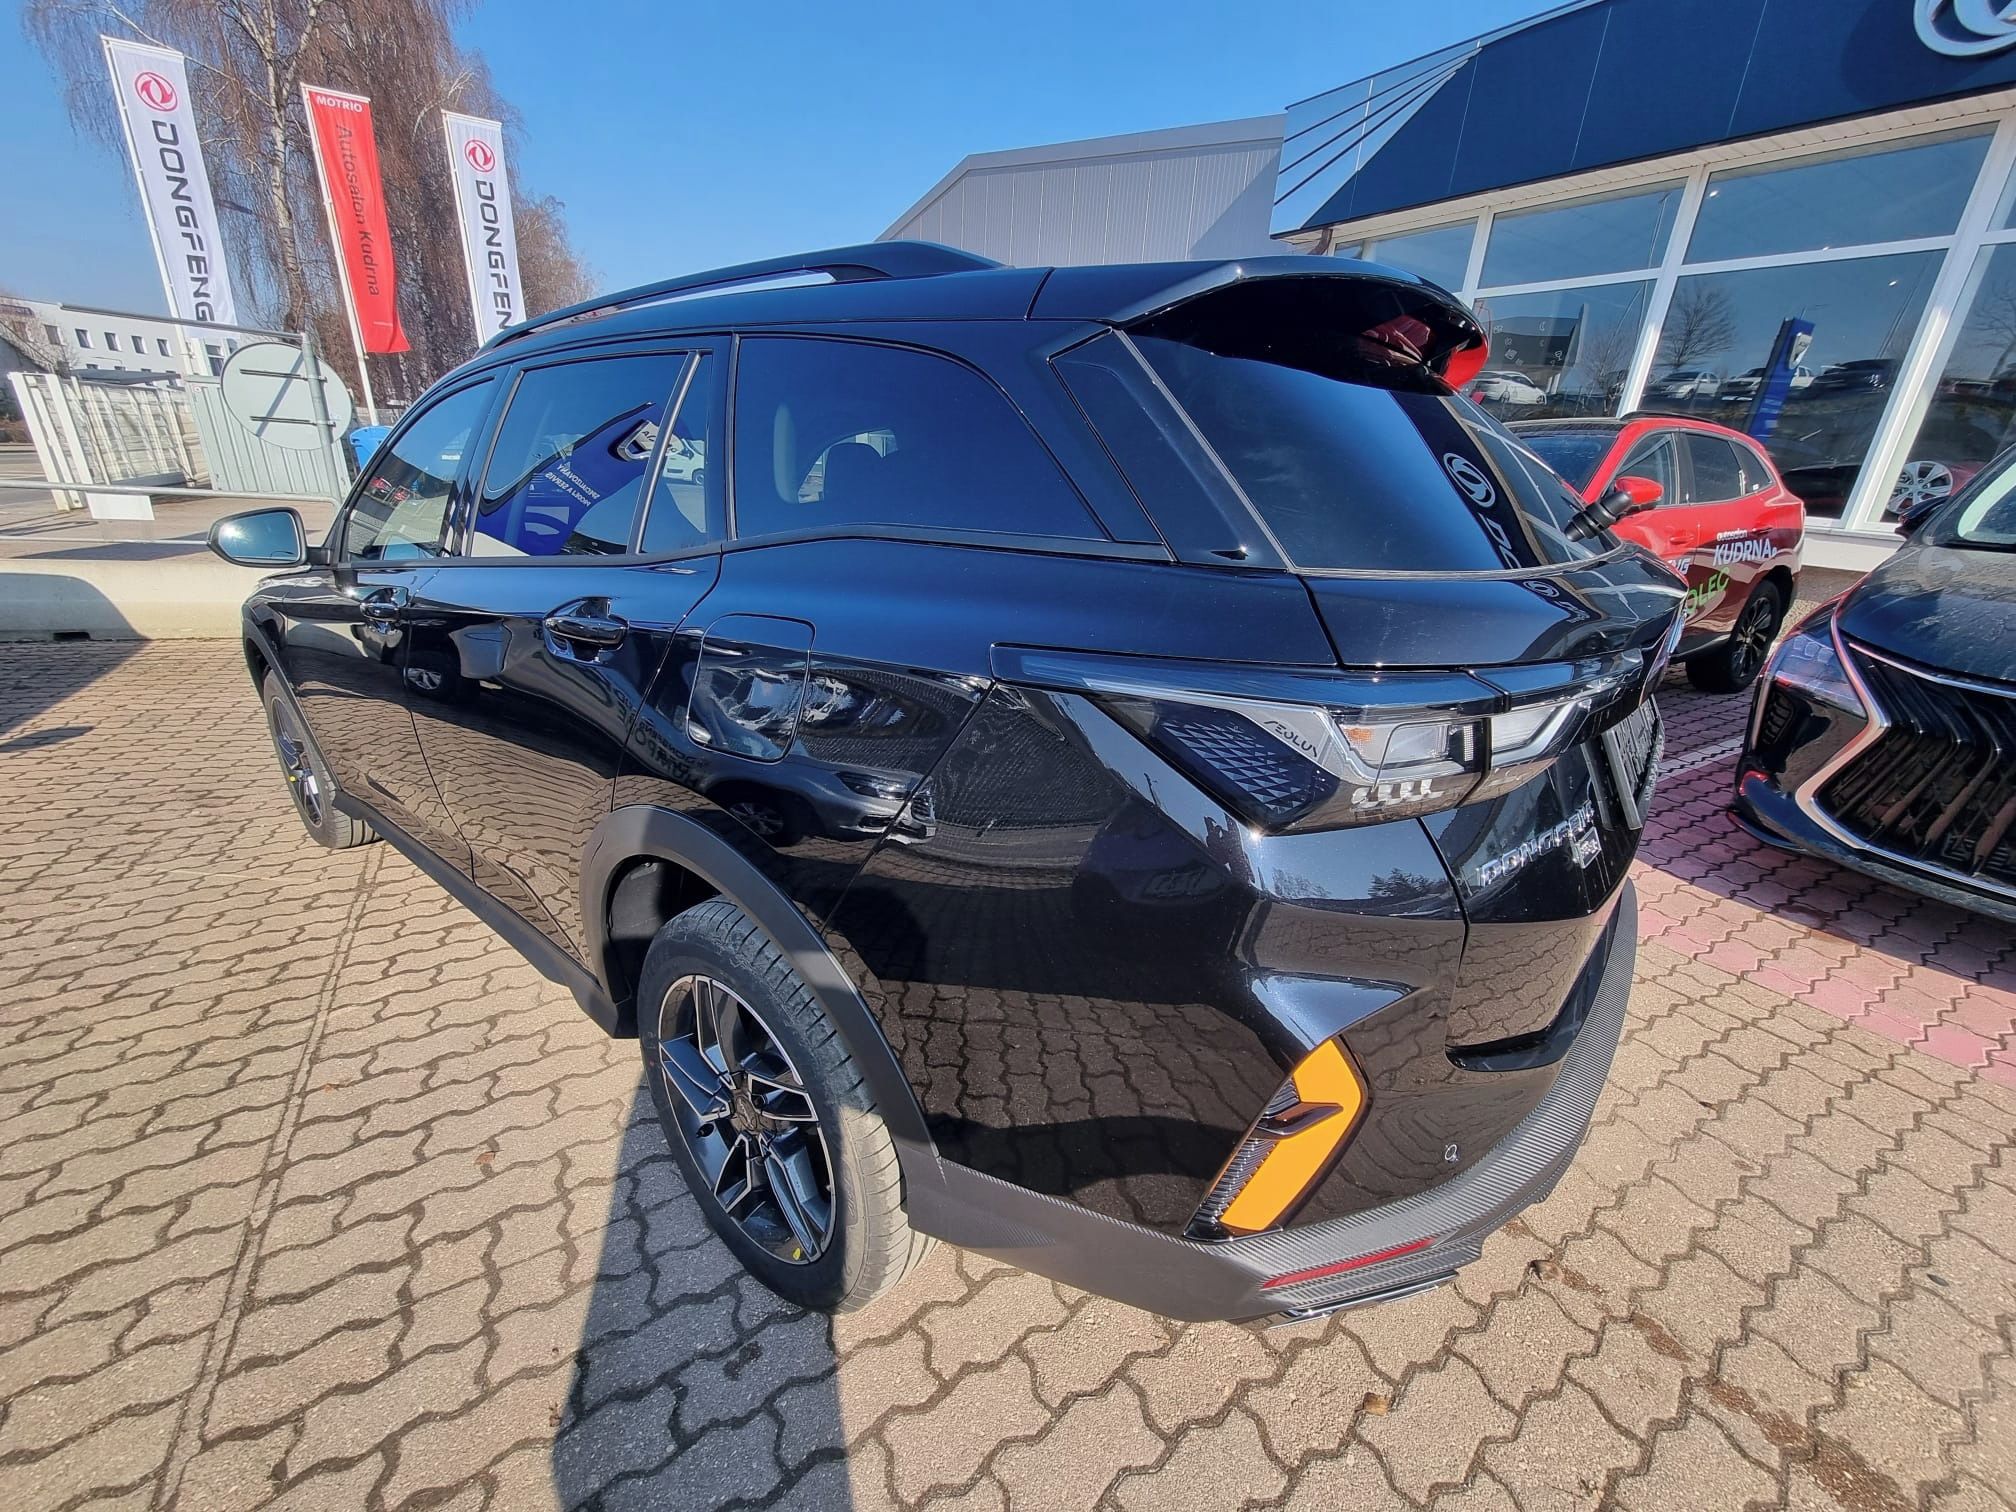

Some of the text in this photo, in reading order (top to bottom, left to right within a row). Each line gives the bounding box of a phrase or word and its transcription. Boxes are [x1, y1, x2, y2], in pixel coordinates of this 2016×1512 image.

[316, 95, 363, 113] MOTRIO
[152, 119, 215, 323] DONGFENG
[336, 122, 380, 296] Autosalon Kudrna
[475, 179, 513, 331] DONGFEN
[1685, 566, 1730, 615] OLEC
[1712, 538, 1772, 567] KUDRNA
